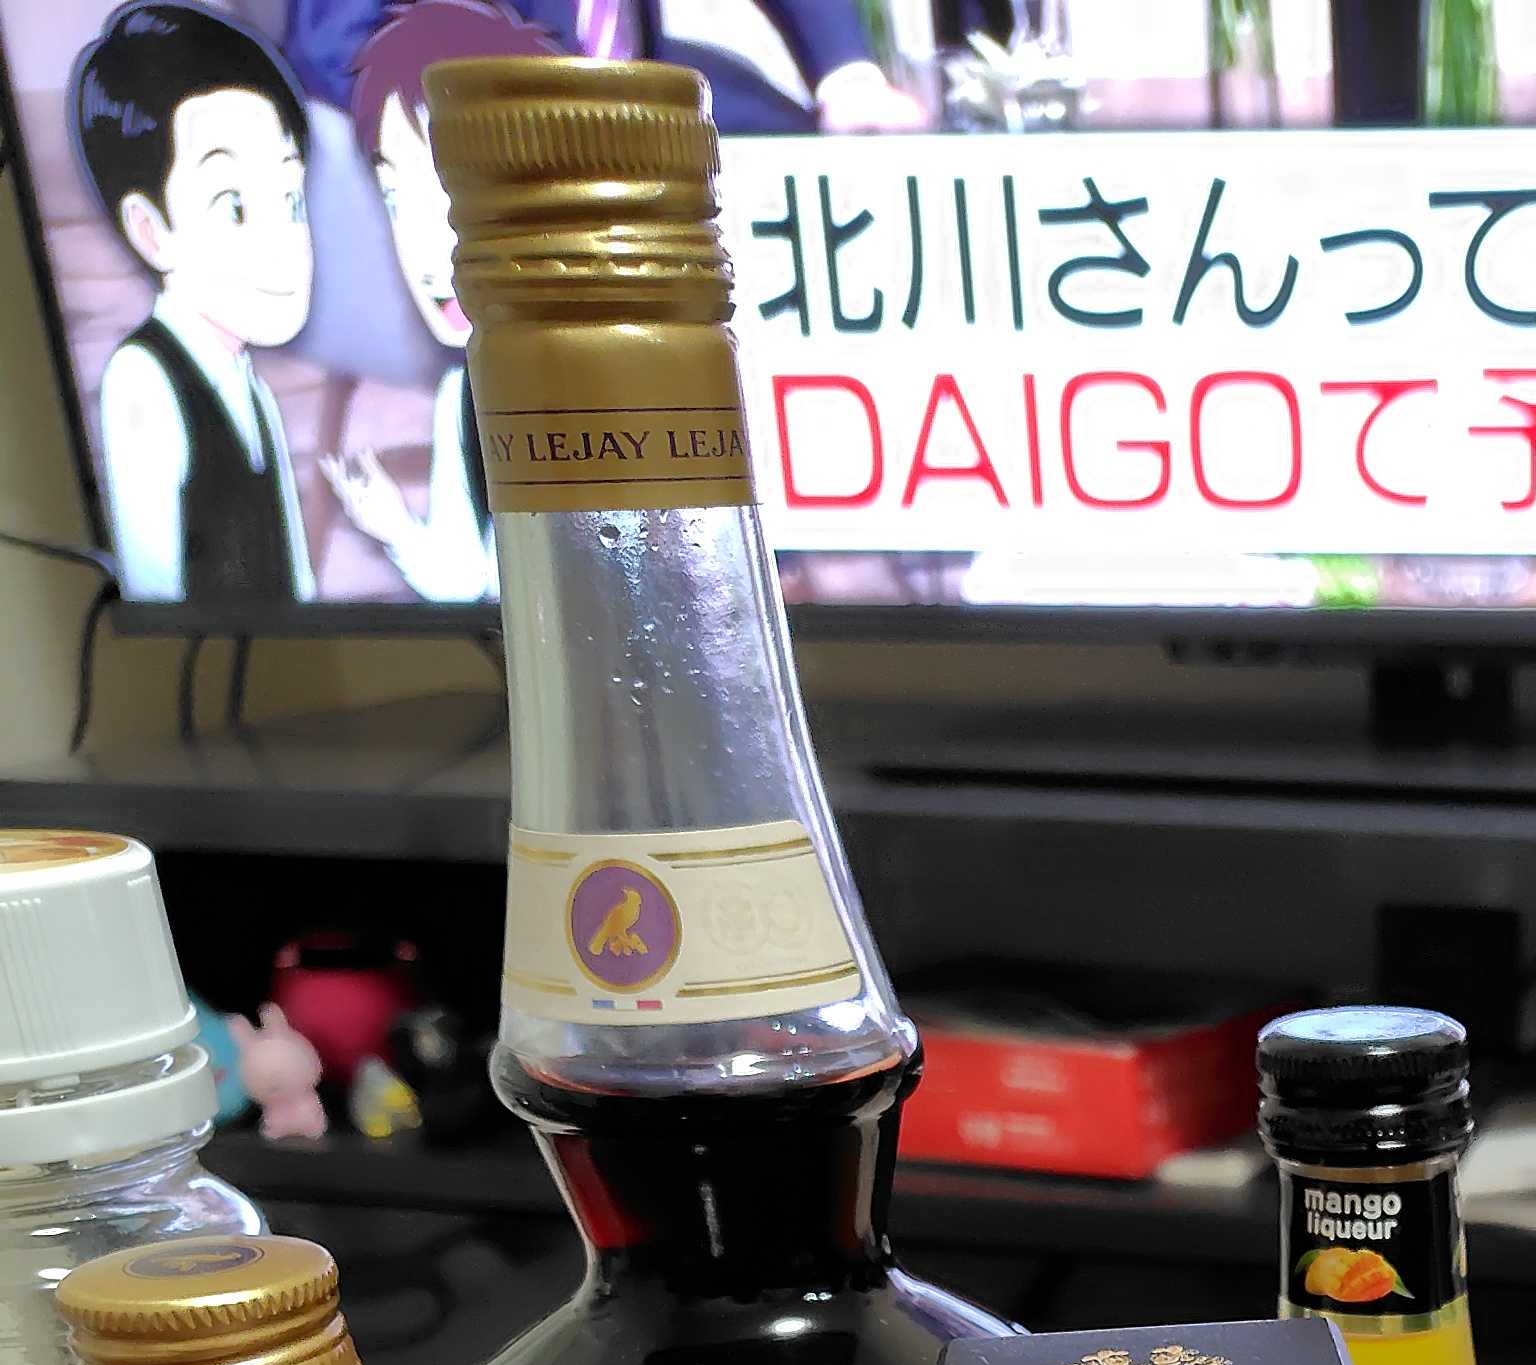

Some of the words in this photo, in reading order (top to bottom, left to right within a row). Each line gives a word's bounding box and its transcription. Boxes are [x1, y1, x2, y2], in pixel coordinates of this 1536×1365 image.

[526, 430, 650, 461] LEJAY
[667, 429, 745, 458] LEJA
[1303, 1187, 1402, 1219] mango
[1306, 1211, 1398, 1240] liqueur
